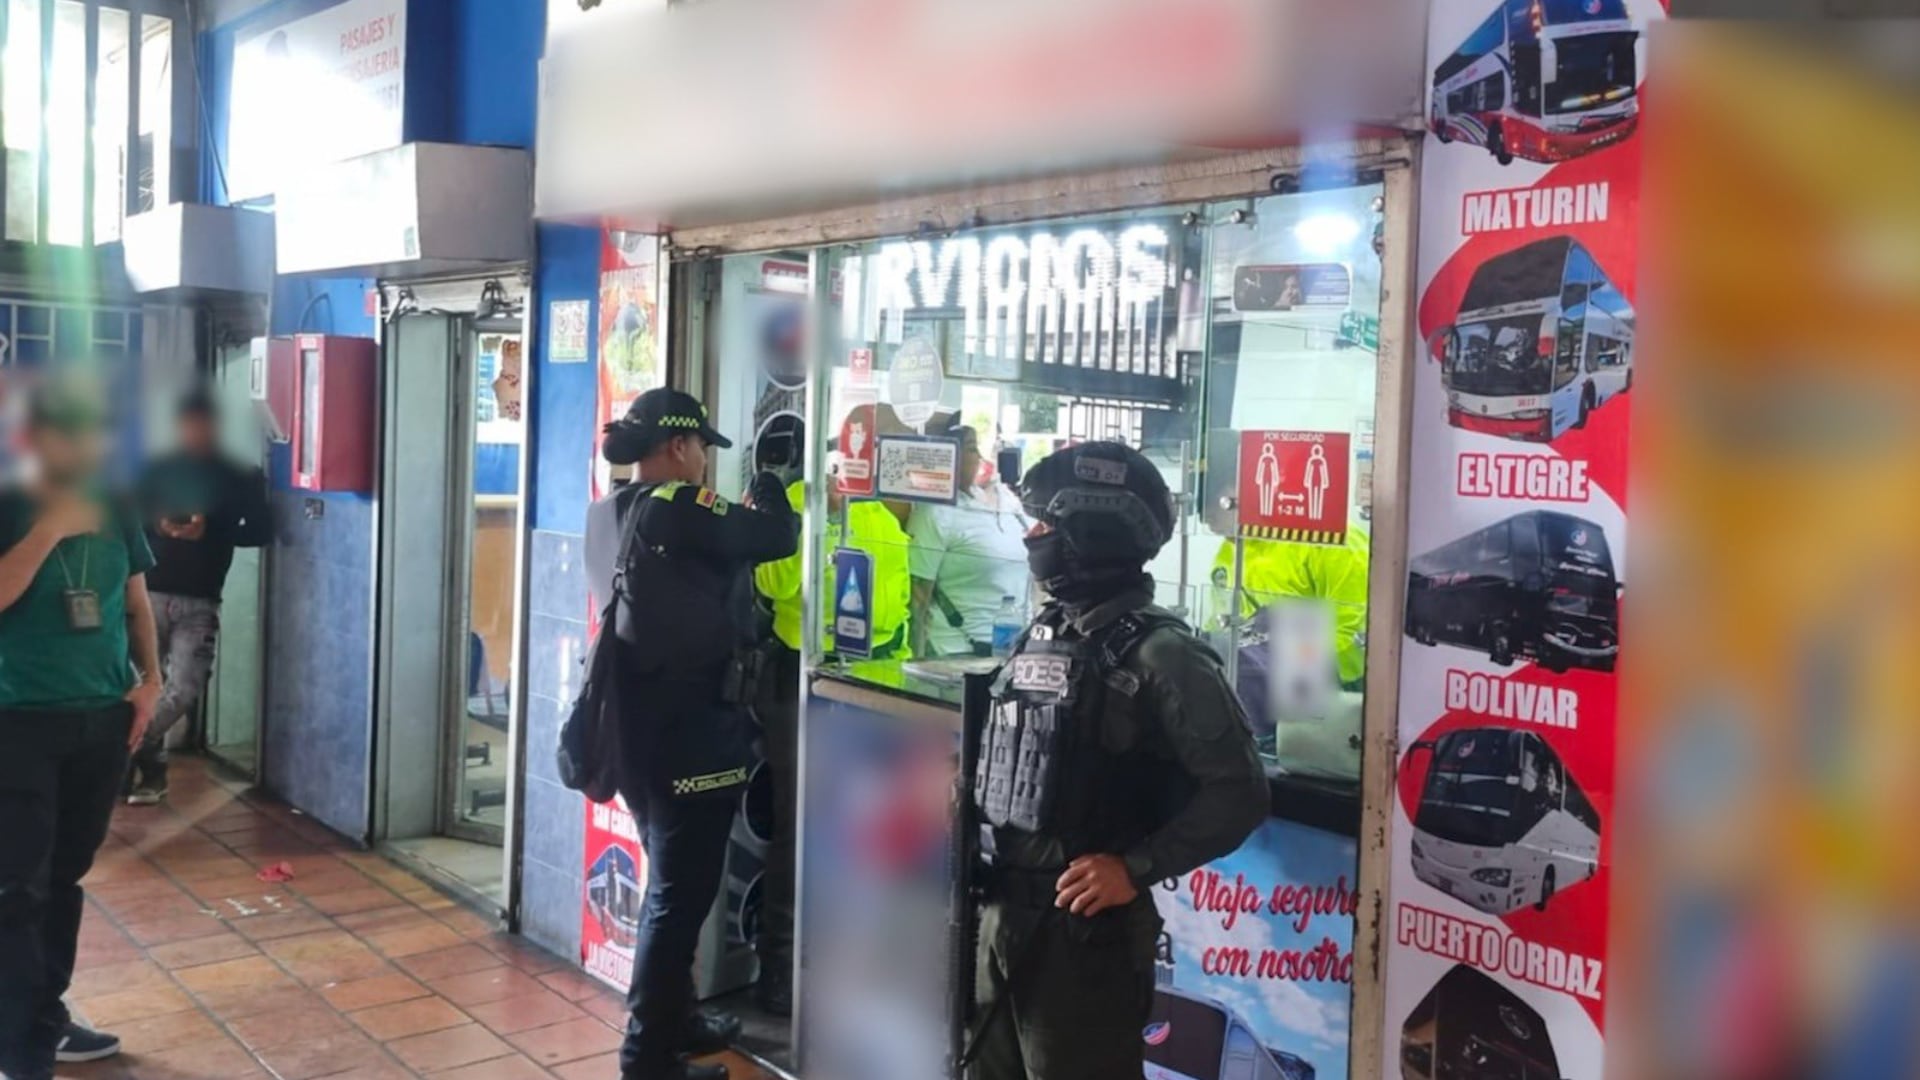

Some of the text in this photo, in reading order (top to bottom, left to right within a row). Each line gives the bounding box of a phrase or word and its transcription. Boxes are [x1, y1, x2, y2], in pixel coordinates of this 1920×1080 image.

[340, 13, 396, 54] PASAJES Y
[1463, 181, 1609, 233] MATURIN
[1263, 431, 1325, 443] POR SEGURIDAD
[1460, 456, 1589, 499] EL TIGRE
[1277, 505, 1305, 516] 1-2 M
[1447, 673, 1579, 729] BOLIVAR
[1190, 868, 1262, 931] Viaja
[1201, 945, 1253, 977] con
[1257, 936, 1353, 984] nosotro
[1398, 907, 1603, 1001] PUERTO ORDAZ
